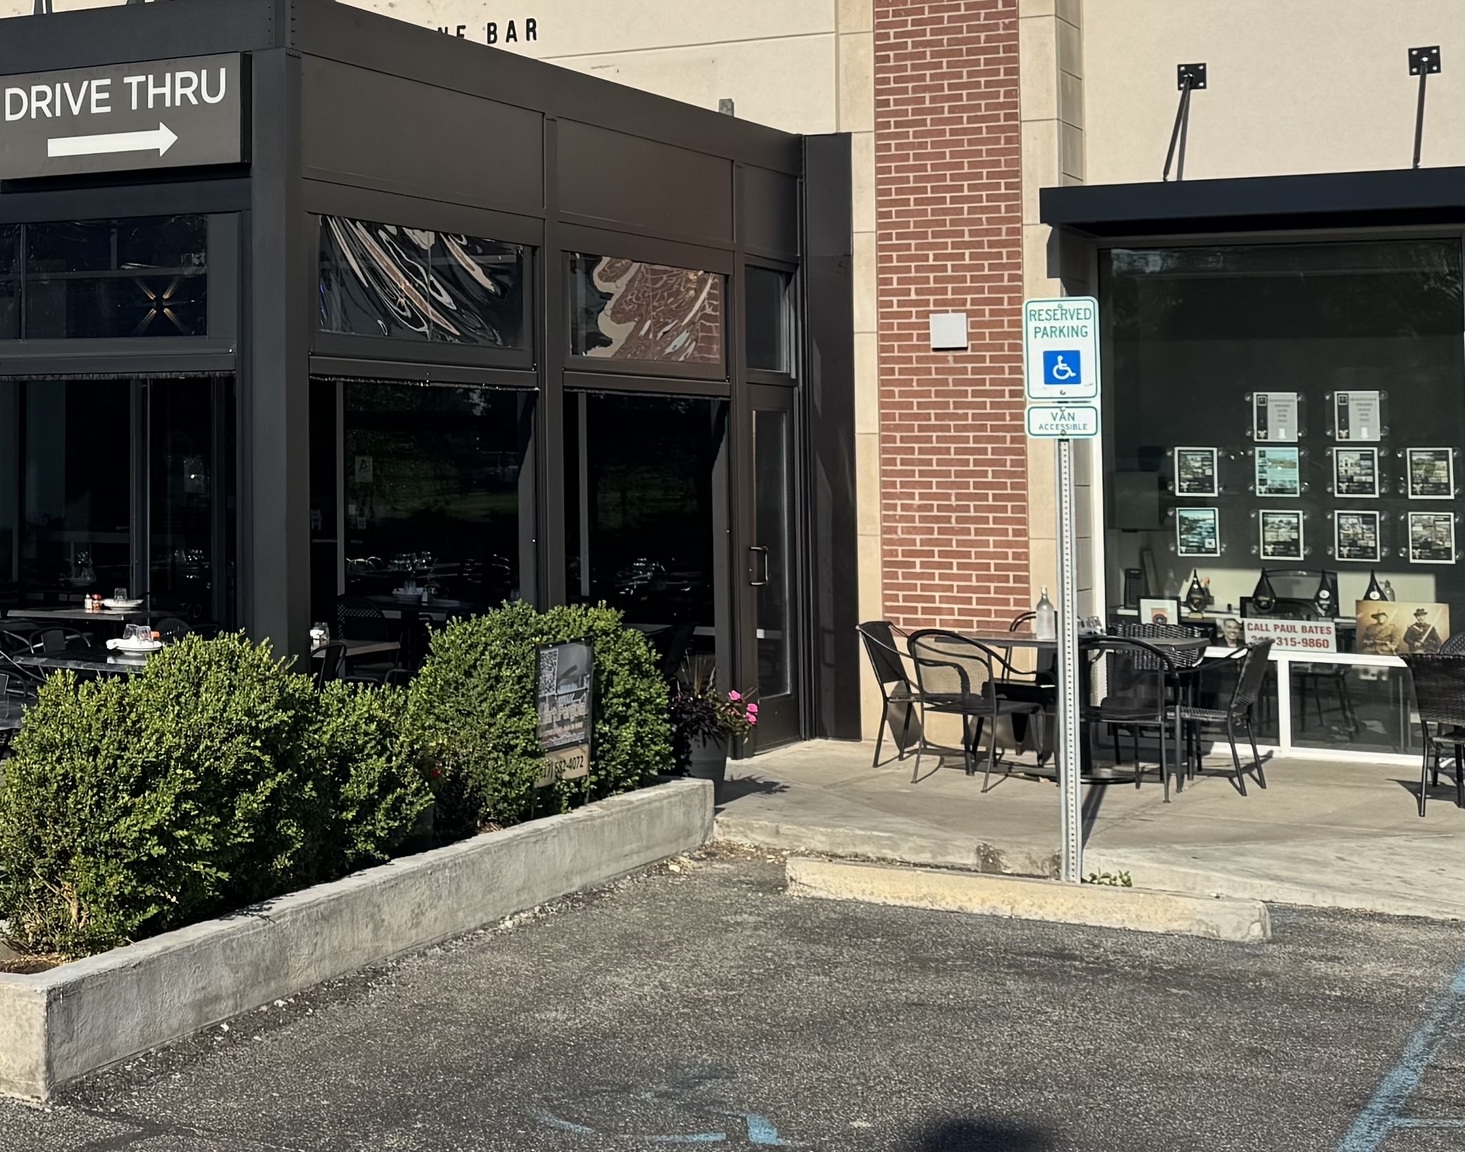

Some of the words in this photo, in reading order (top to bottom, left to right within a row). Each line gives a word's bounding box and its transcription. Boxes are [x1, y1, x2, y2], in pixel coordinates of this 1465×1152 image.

[486, 17, 537, 45] BAR
[3, 77, 113, 123] DRIVE
[122, 66, 228, 112] THRU
[1029, 307, 1092, 323] RESERVED
[1033, 324, 1089, 339] PARKING
[1050, 411, 1076, 422] VAN
[1038, 423, 1088, 432] ACCESSIBLE
[1247, 622, 1271, 633] CALL
[1273, 623, 1298, 634] PAUL
[1301, 625, 1332, 636] BATES
[1250, 635, 1330, 649] 315-9860
